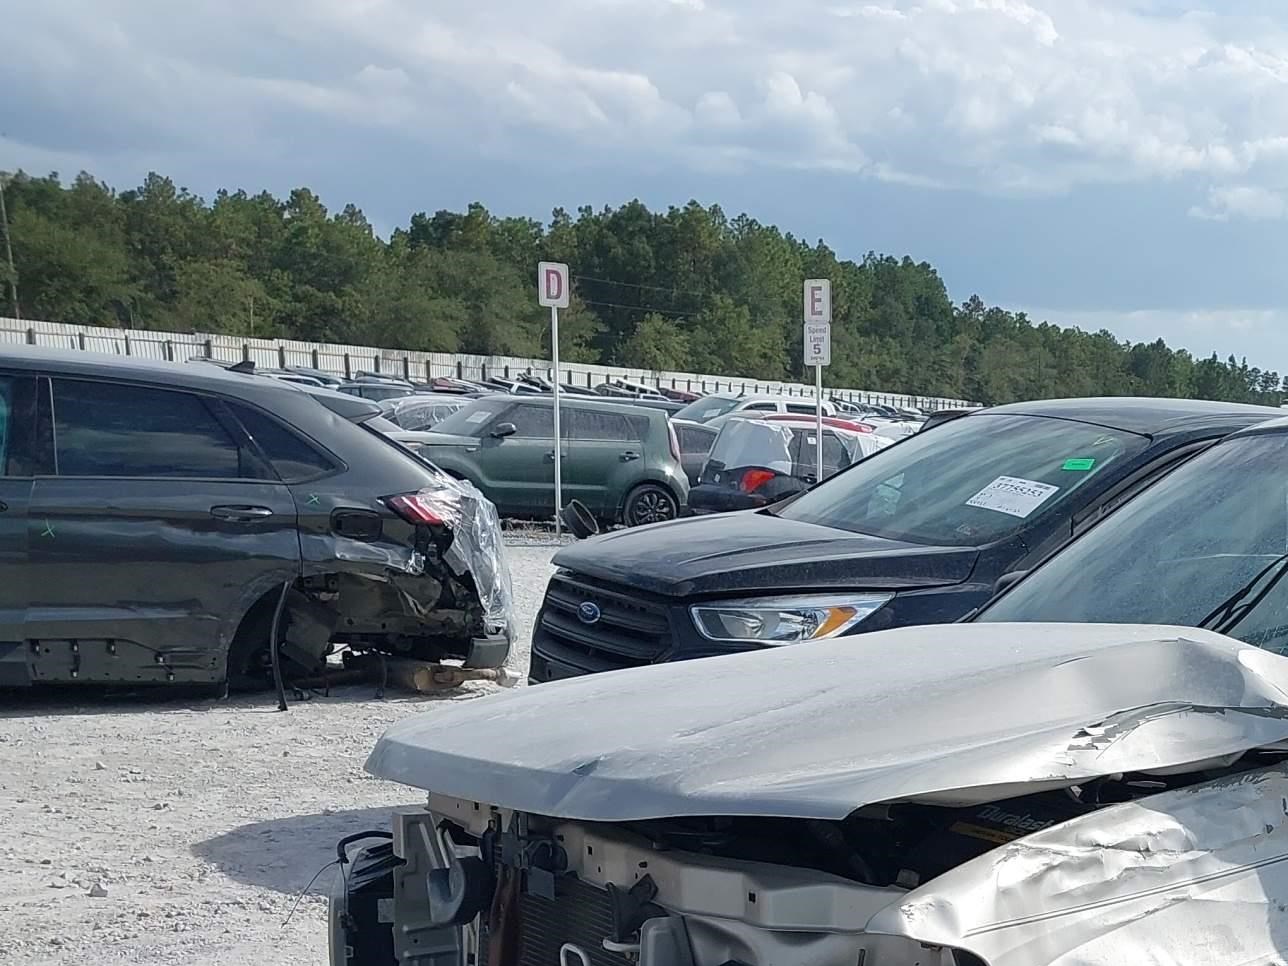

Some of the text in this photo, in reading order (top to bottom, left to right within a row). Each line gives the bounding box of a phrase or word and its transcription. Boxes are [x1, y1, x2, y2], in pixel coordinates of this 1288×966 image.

[546, 269, 562, 299] D
[810, 286, 823, 316] E
[808, 326, 826, 335] Speed
[813, 343, 821, 355] 5
[976, 805, 1056, 831] Duralast
